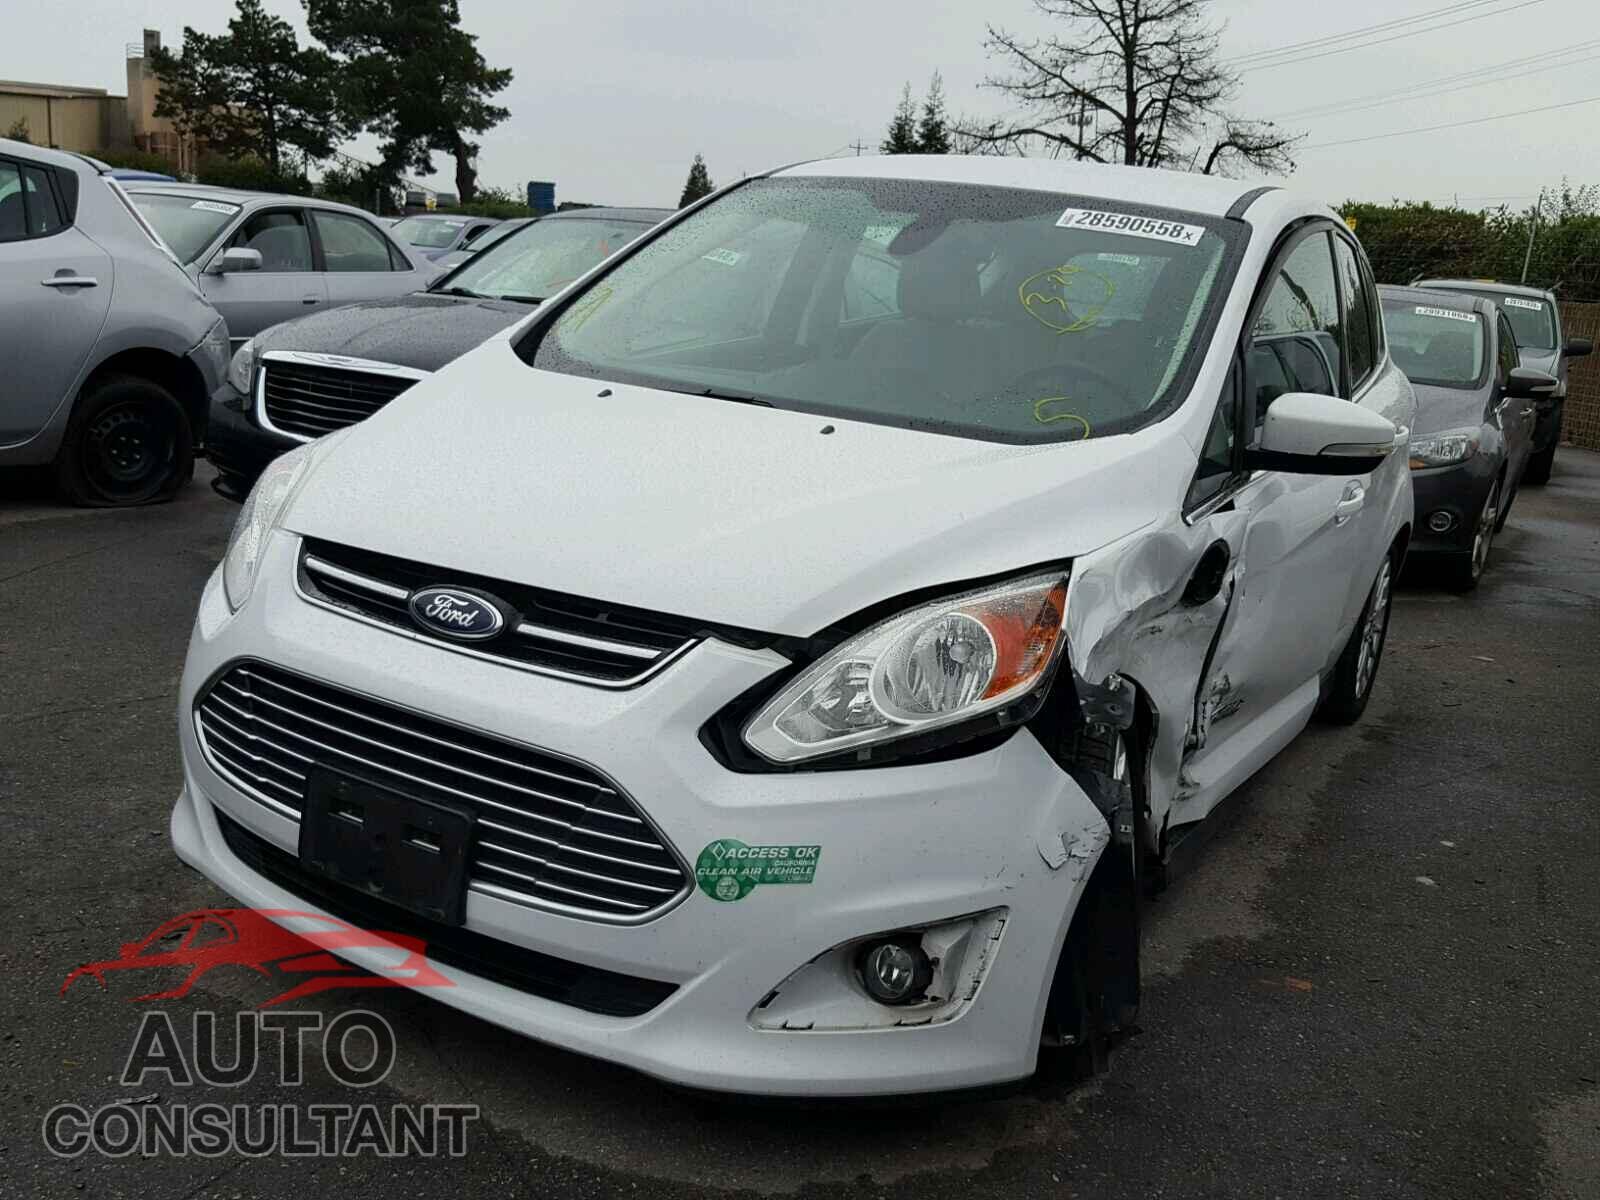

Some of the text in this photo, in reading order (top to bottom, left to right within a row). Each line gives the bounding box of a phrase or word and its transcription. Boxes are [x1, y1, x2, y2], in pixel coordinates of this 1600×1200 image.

[425, 594, 480, 628] Ford
[725, 847, 819, 859] ACCESS OK
[697, 866, 814, 876] CLEAN AIR VEHICLE
